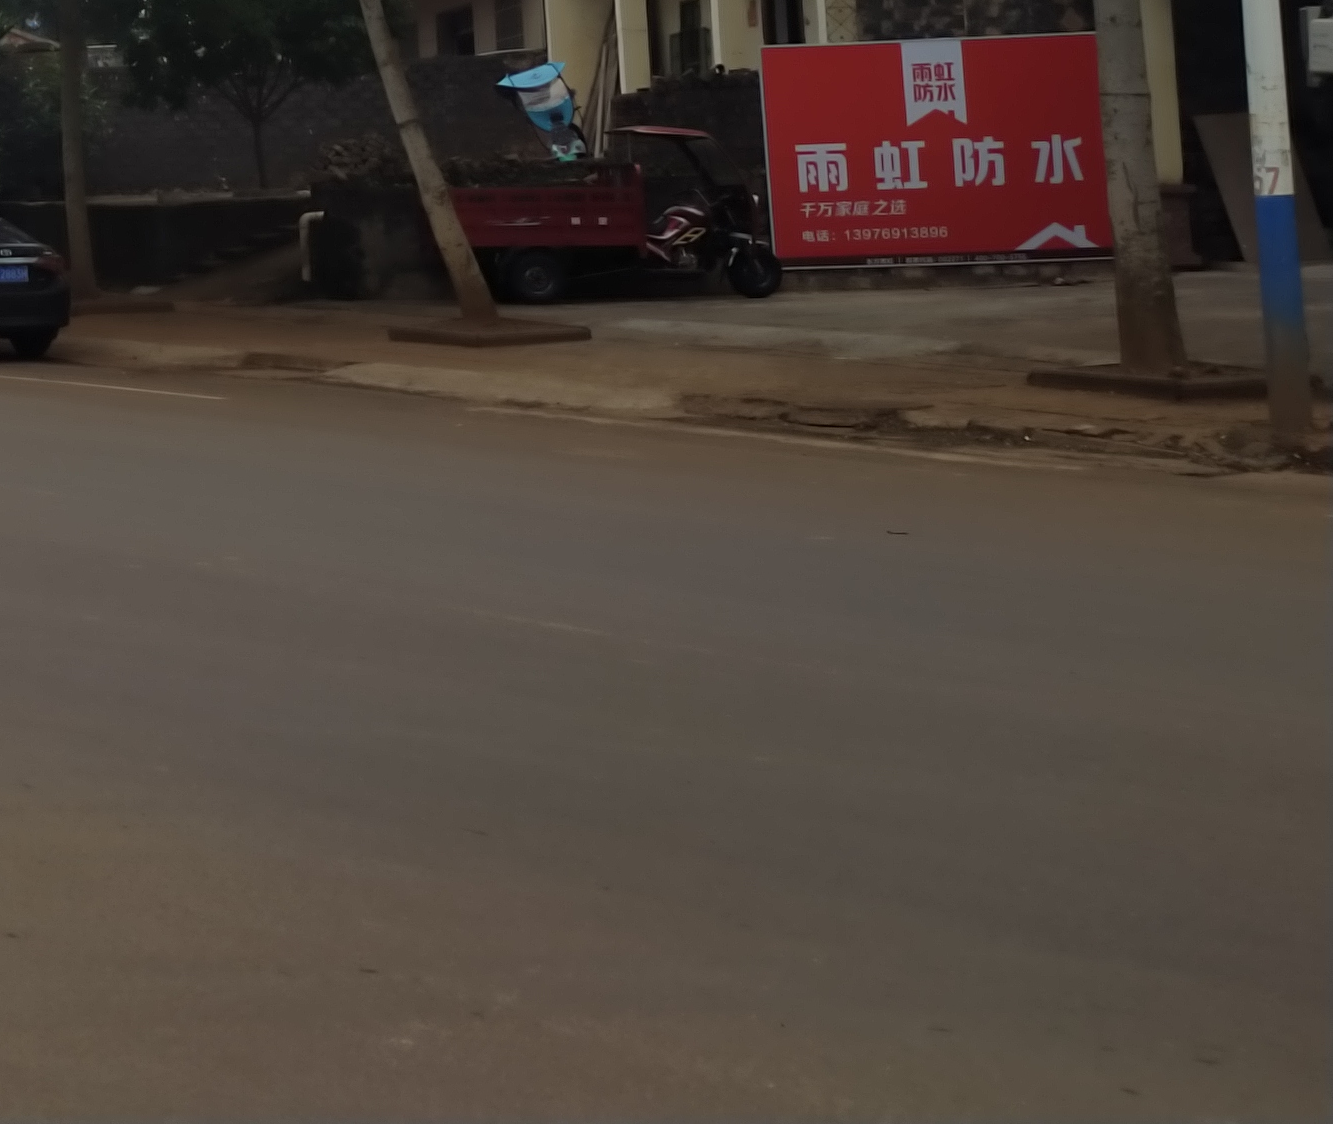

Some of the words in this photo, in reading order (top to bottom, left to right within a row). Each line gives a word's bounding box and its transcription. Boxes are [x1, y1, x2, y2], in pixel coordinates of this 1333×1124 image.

[911, 62, 955, 82] 雨虹
[913, 82, 956, 103] 防水
[794, 135, 1084, 193] 雨虹防水
[800, 199, 907, 218] 千万家庭之选
